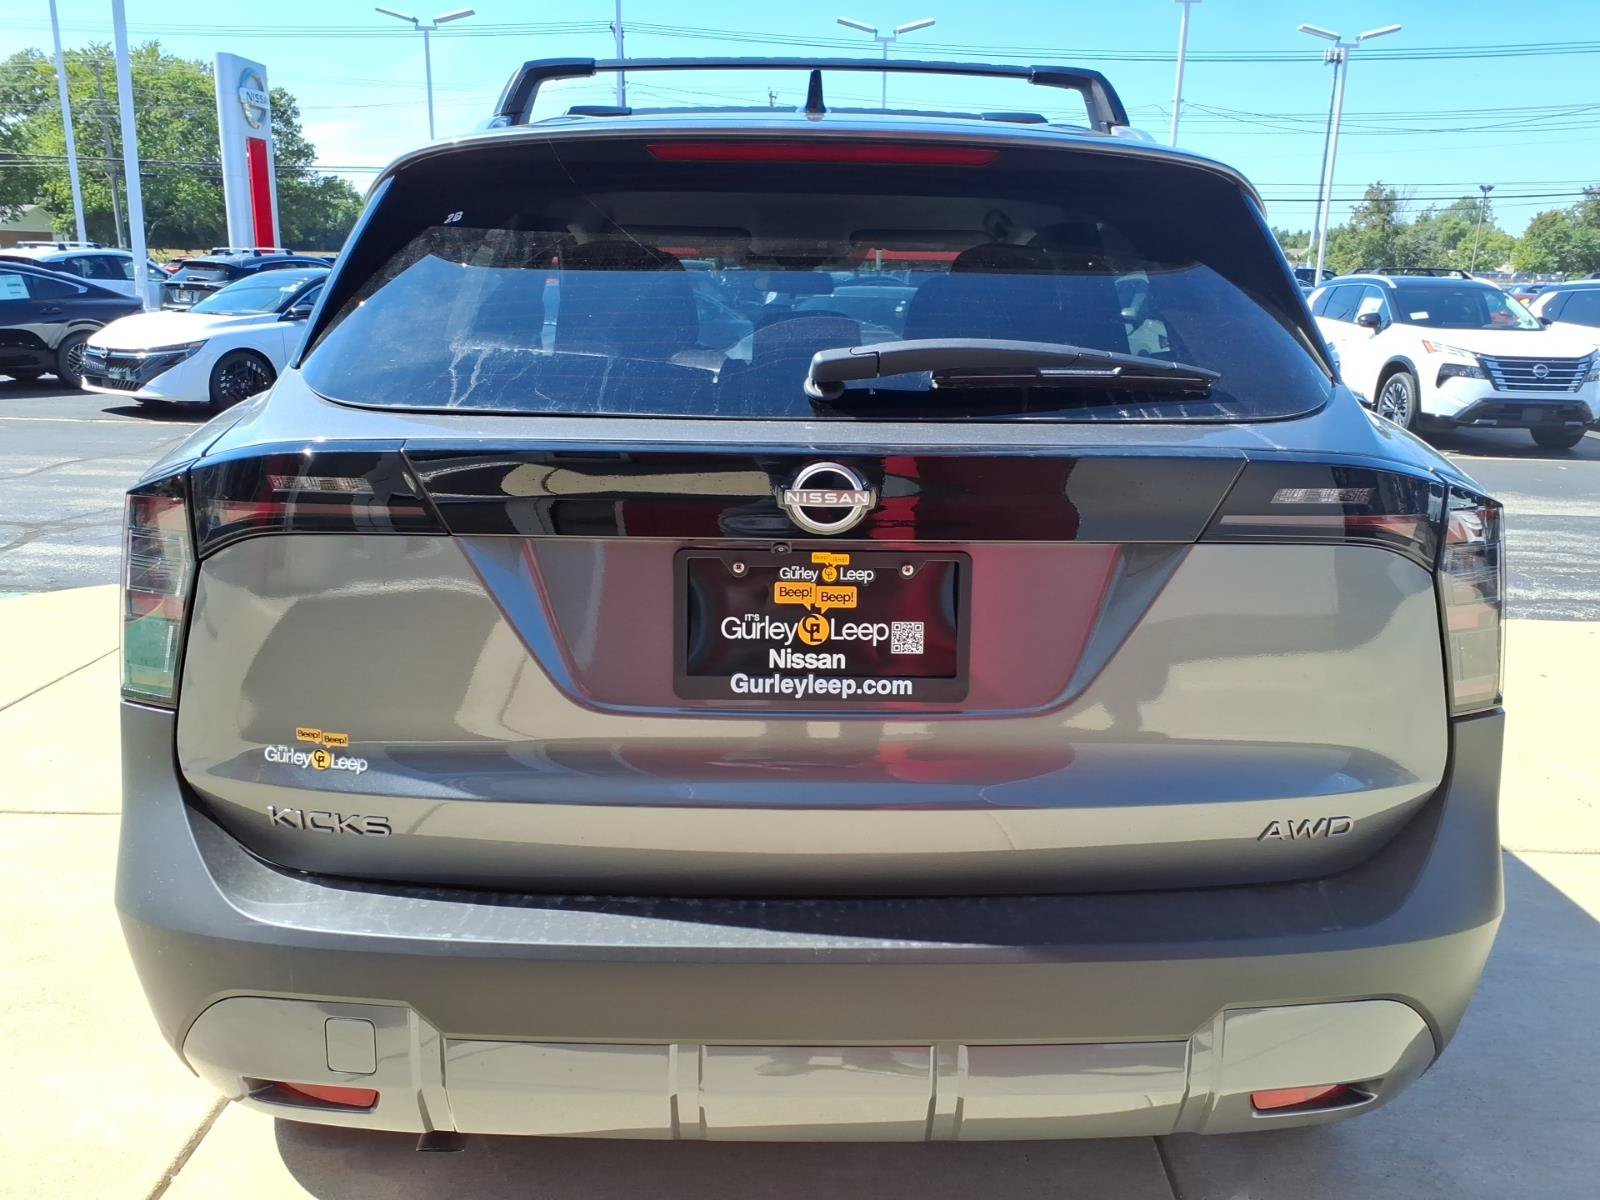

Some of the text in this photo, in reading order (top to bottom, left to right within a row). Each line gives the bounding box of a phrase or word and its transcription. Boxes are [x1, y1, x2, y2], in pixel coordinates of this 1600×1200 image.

[786, 492, 869, 504] NISSAN
[779, 566, 819, 583] Gurley
[840, 566, 875, 584] Leep
[779, 586, 854, 605] Beep! Beep!
[720, 615, 799, 646] Gurley
[830, 617, 890, 647] Leep
[768, 648, 846, 669] Nissan
[729, 673, 913, 699] Gurleyleep.com
[324, 734, 348, 745] Beep!
[264, 746, 311, 769] Gurley
[330, 753, 369, 775] Leep
[267, 805, 392, 838] KICKS
[1257, 815, 1354, 842] AWD
